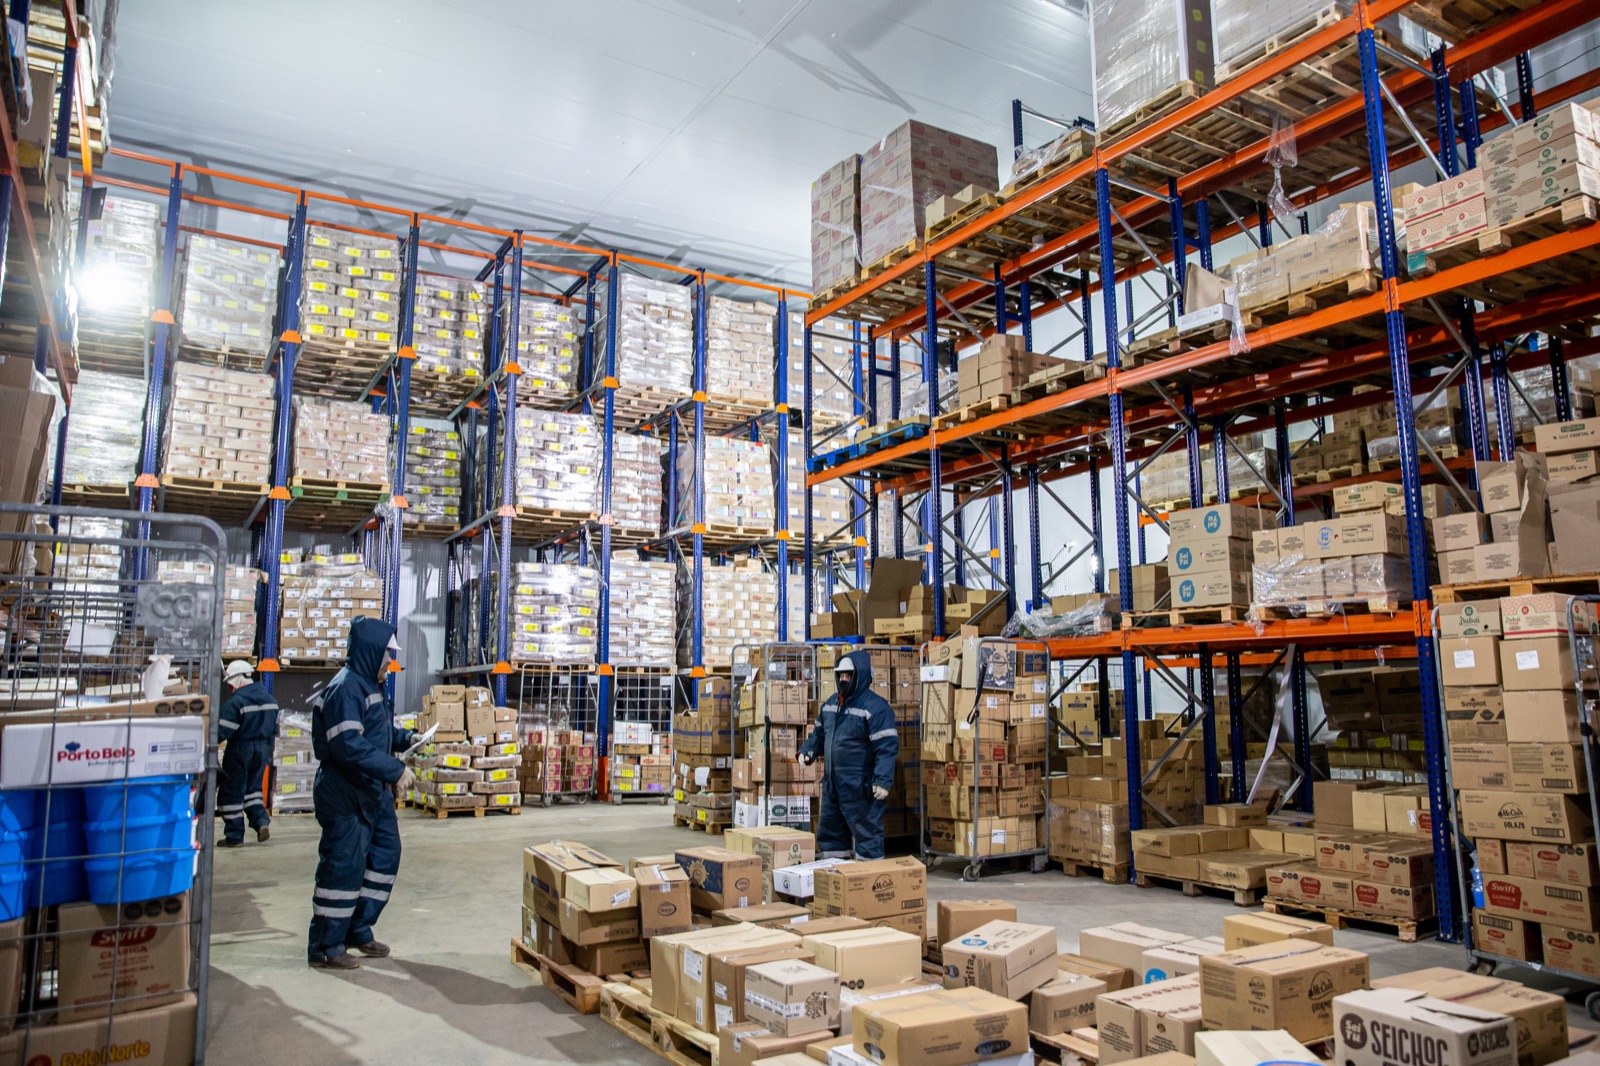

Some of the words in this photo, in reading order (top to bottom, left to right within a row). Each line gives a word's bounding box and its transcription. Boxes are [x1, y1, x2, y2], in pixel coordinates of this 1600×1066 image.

[1537, 154, 1557, 168] Dubai
[1540, 183, 1560, 198] Dubai
[1459, 616, 1480, 626] Dubai
[1461, 700, 1487, 708] Simplot
[57, 749, 100, 762] Porto
[102, 747, 136, 760] Belo
[1502, 807, 1524, 817] McCain
[1540, 851, 1558, 860] Swift
[1491, 882, 1516, 893] Swift
[1345, 1019, 1361, 1032] Sei
[1344, 1030, 1362, 1042] Tu
